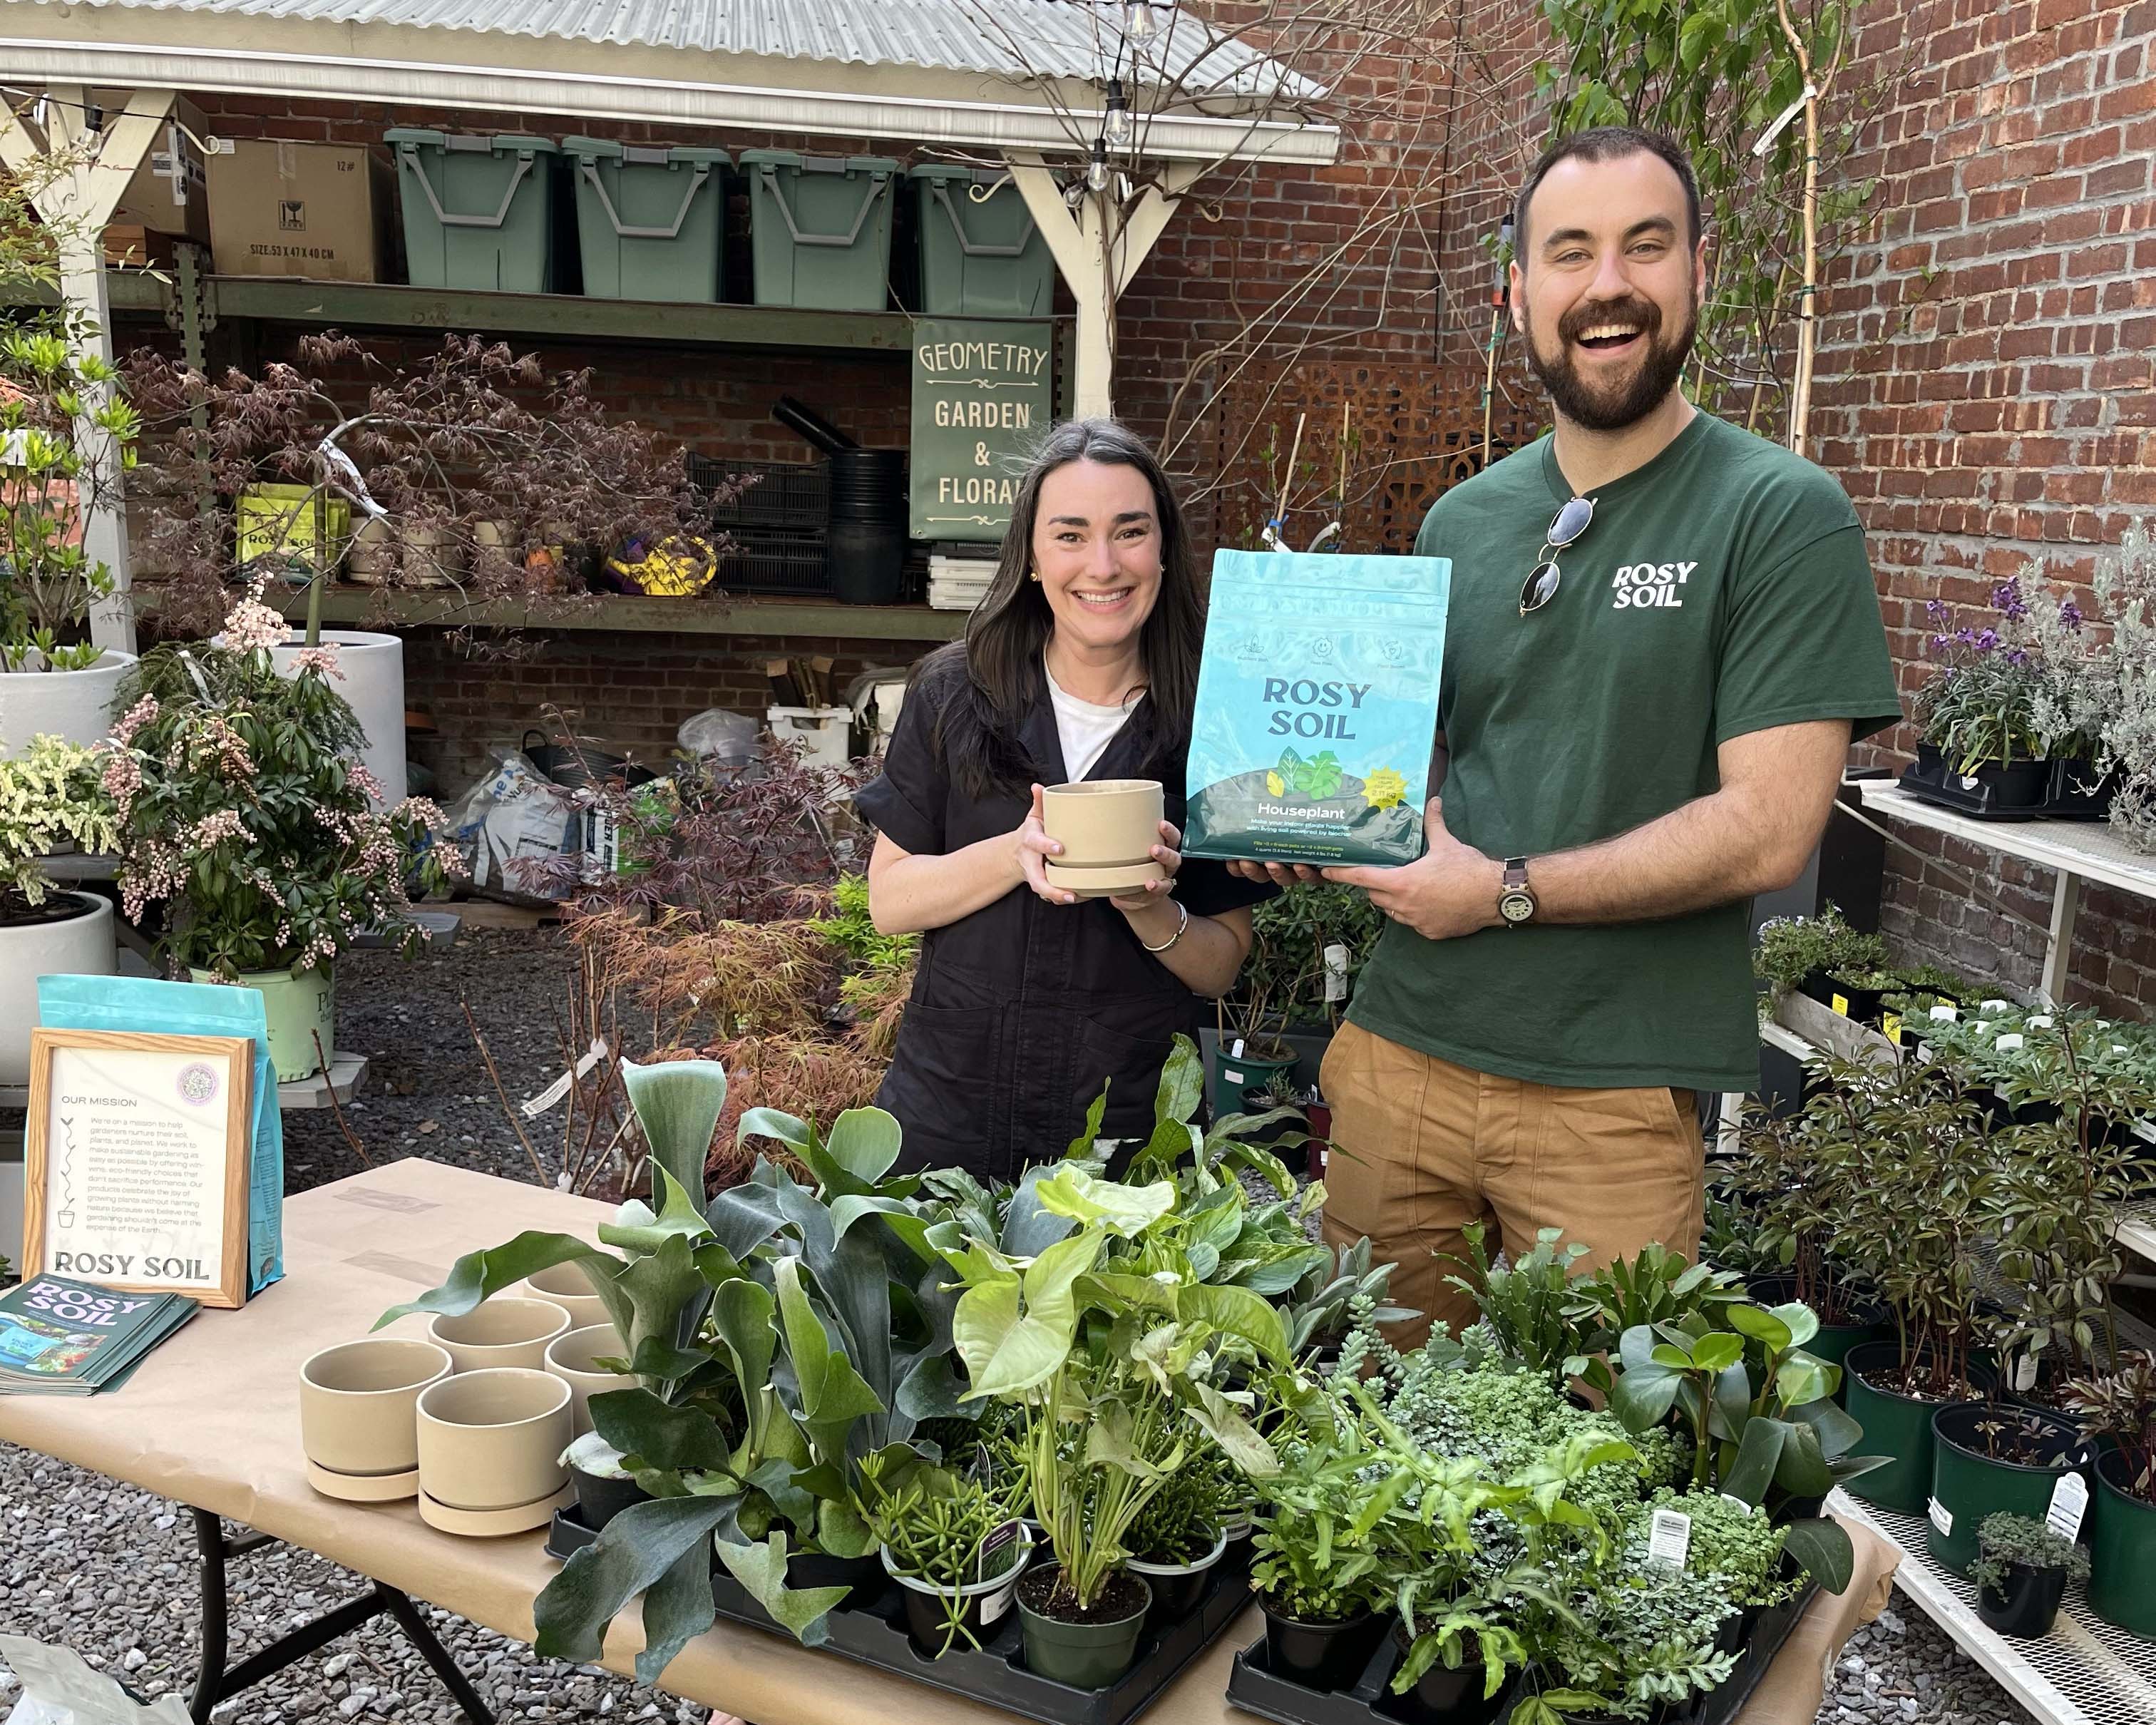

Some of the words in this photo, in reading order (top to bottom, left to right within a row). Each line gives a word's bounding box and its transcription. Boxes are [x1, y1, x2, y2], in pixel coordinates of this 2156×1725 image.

[337, 160, 354, 171] 12#
[291, 247, 299, 257] 47
[309, 249, 319, 259] 40
[322, 250, 334, 260] CM
[919, 342, 1048, 375] GEOMETRY
[935, 401, 1030, 428] GARDEN
[975, 441, 990, 466] &
[1612, 562, 1698, 588] ROSY
[1613, 584, 1683, 608] SOIL
[1263, 677, 1372, 708] ROSY
[1268, 710, 1355, 740] SOIL
[1258, 803, 1345, 819] Houseplant
[61, 1096, 86, 1105] OUR
[90, 1097, 137, 1107] MISSION
[153, 1150, 188, 1159] gardening
[87, 1214, 123, 1223] gardening
[55, 1251, 135, 1275] ROSY
[143, 1256, 209, 1279] SOIL
[28, 1282, 150, 1314] ROSY
[23, 1296, 117, 1326] SOIL
